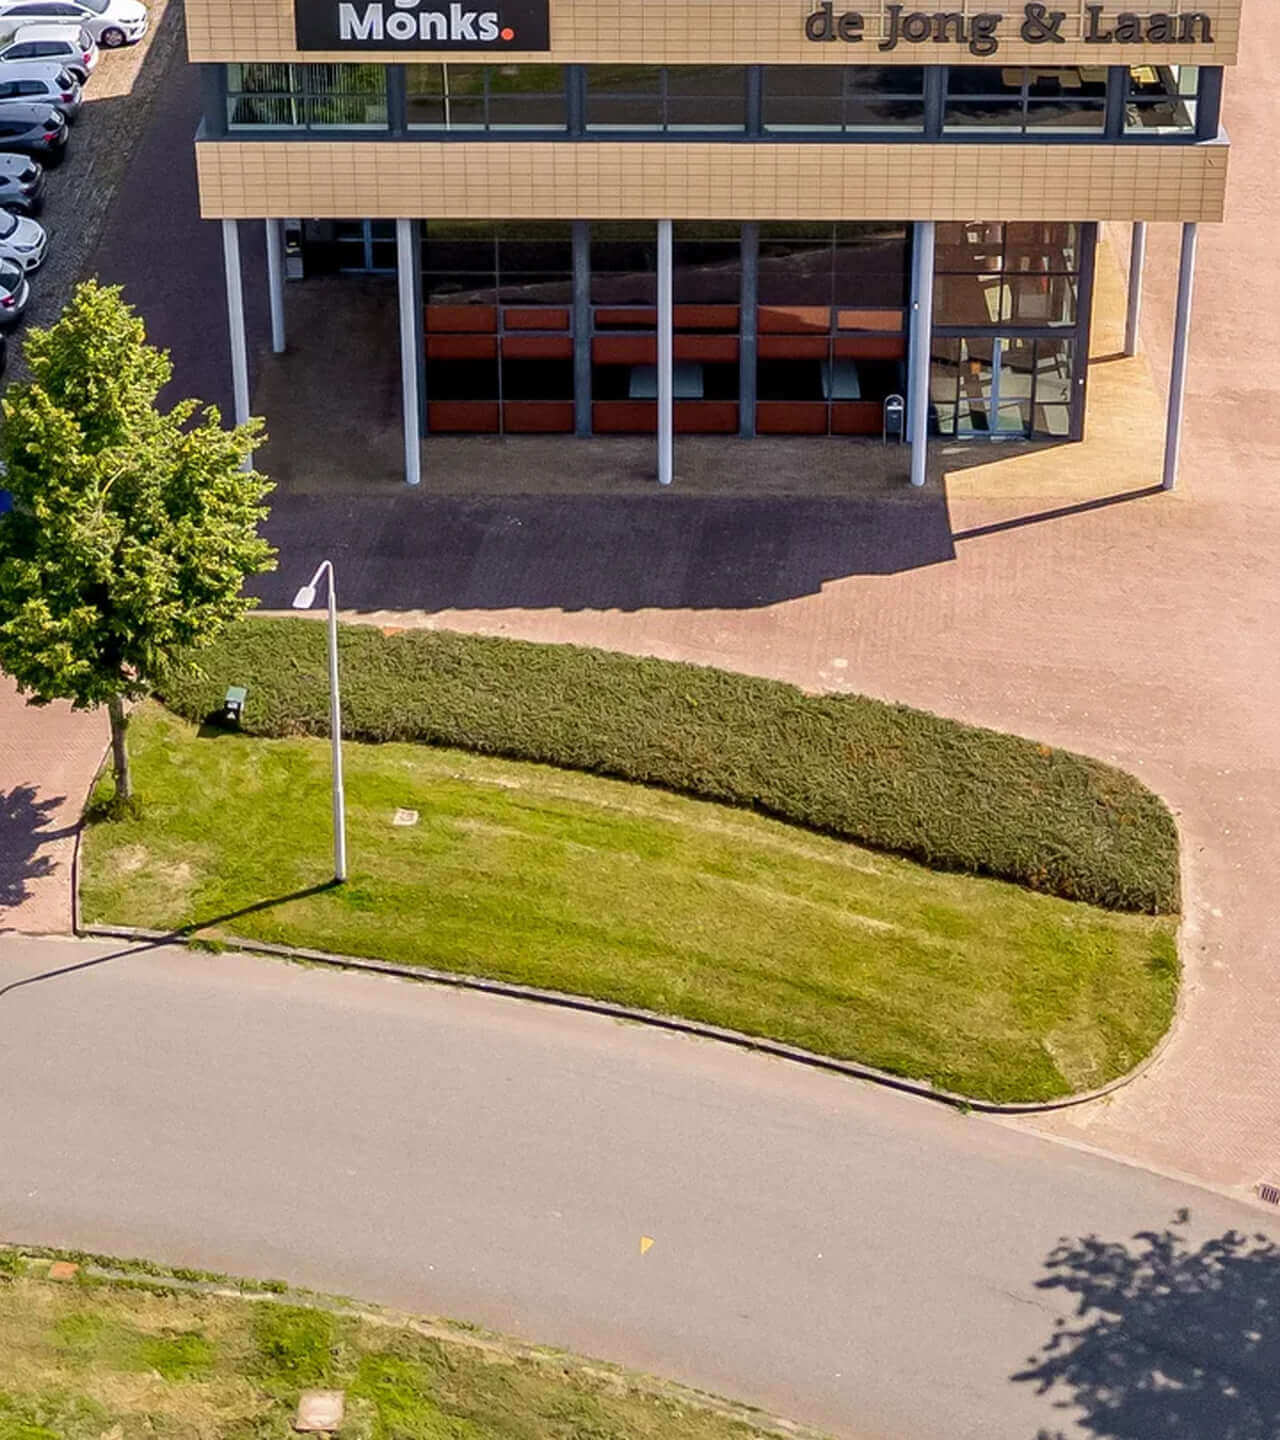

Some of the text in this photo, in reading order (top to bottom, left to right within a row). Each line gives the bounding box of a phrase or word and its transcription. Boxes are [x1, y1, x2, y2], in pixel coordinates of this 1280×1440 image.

[338, 2, 515, 41] Monks.
[805, 1, 1215, 56] de Jong & Laan
